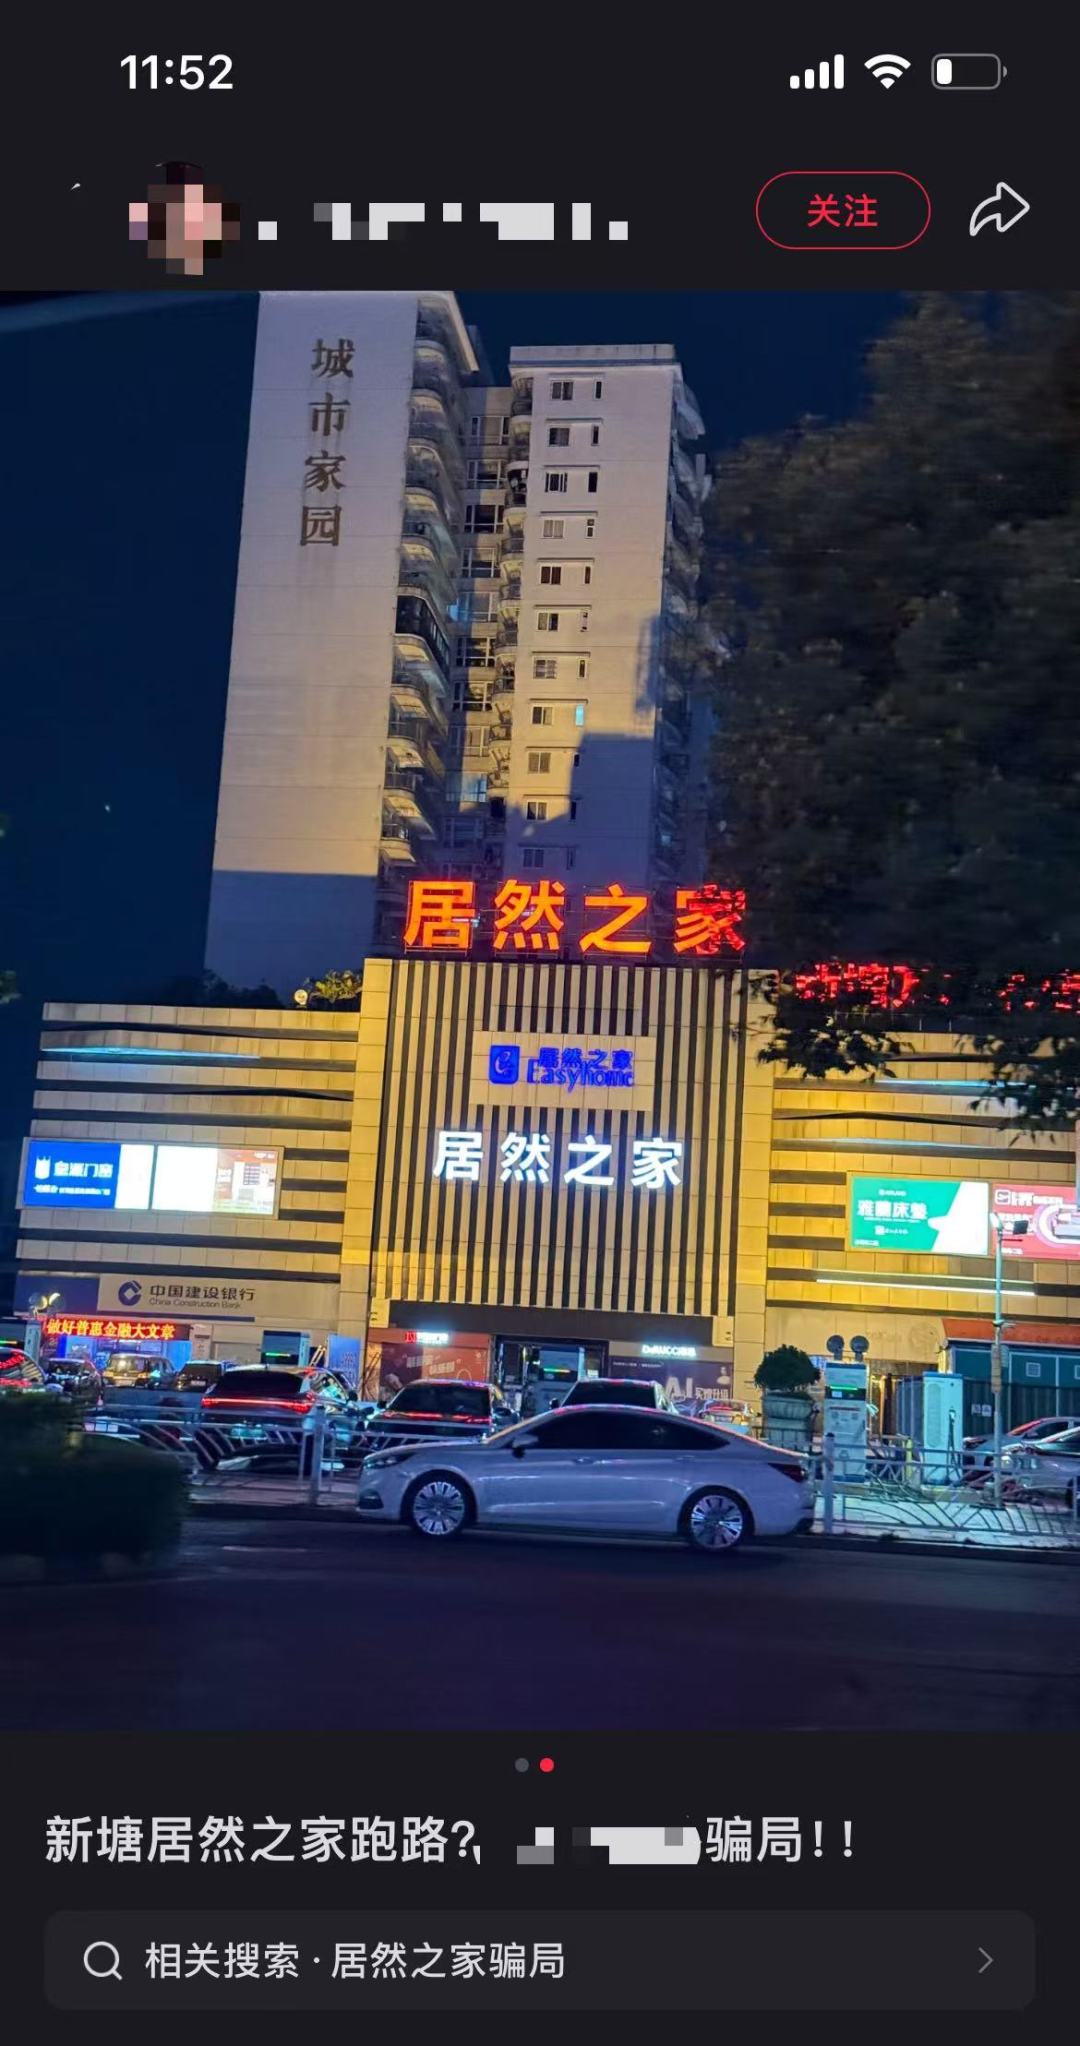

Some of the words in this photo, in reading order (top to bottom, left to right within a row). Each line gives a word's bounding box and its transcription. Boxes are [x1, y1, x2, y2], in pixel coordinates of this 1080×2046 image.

[299, 337, 356, 547] 城市家园
[402, 878, 747, 956] 居然之家
[538, 1047, 634, 1070] 居然之家
[526, 1058, 635, 1093] Easyhome
[432, 1130, 684, 1189] 居然之家
[149, 1284, 256, 1301] 中国建设银行
[149, 1297, 171, 1306] China
[173, 1299, 221, 1309] Construction
[221, 1300, 241, 1310] Bank
[46, 1318, 176, 1340] 做好普惠金融大文章
